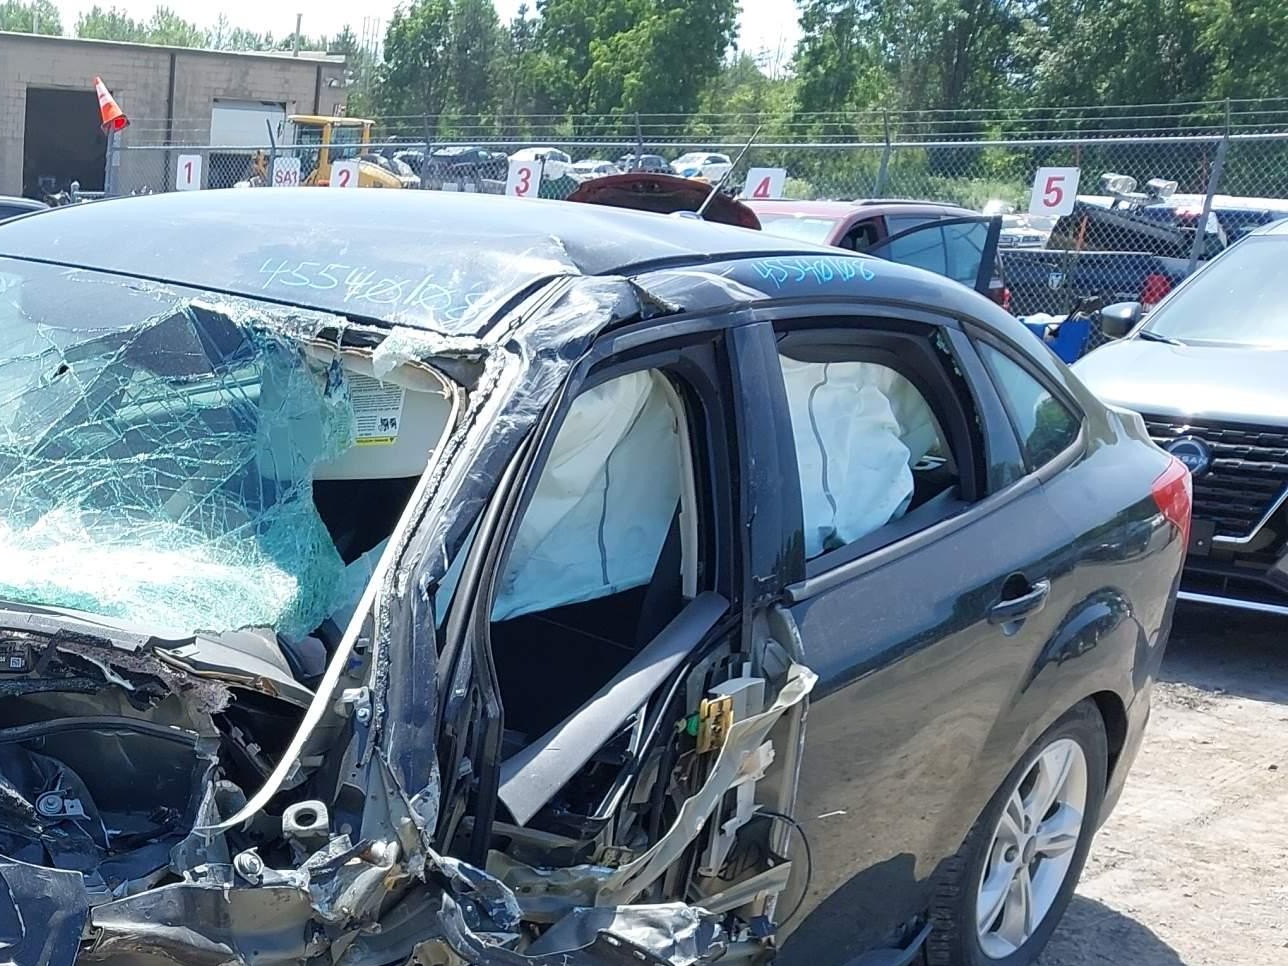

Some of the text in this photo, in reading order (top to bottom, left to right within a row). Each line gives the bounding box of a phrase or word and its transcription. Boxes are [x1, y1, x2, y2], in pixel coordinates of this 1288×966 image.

[184, 161, 193, 184] 1
[275, 169, 298, 184] SA1
[338, 168, 351, 187] 2
[514, 167, 532, 195] 3
[752, 176, 771, 198] 4
[1043, 175, 1065, 207] 5
